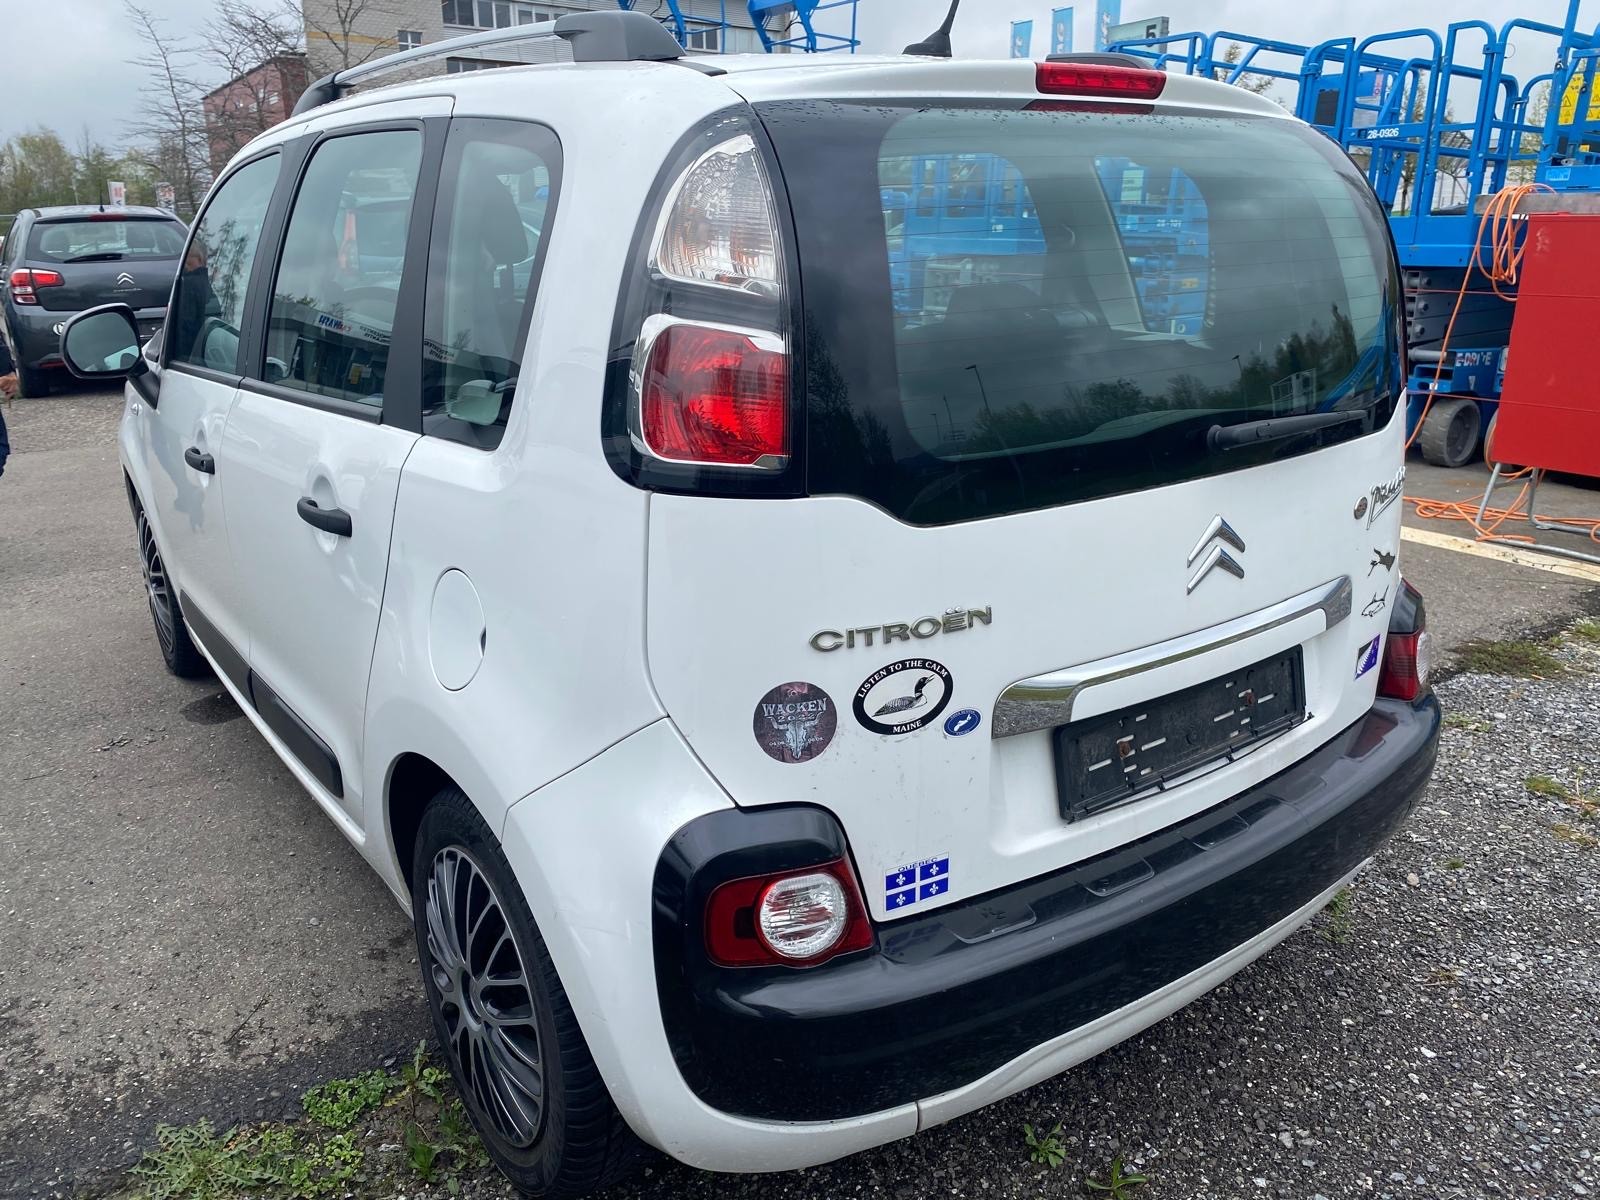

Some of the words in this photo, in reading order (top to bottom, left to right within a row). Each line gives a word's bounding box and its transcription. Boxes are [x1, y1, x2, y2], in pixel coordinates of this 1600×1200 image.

[1146, 24, 1157, 48] 5
[1367, 127, 1399, 140] 28-0926
[809, 605, 993, 653] CITROËN
[857, 668, 887, 698] LISTEN
[888, 663, 903, 673] TO
[904, 660, 924, 668] THE
[925, 661, 949, 678] CALM
[761, 697, 828, 717] WACKEN
[892, 719, 923, 734] MAINE
